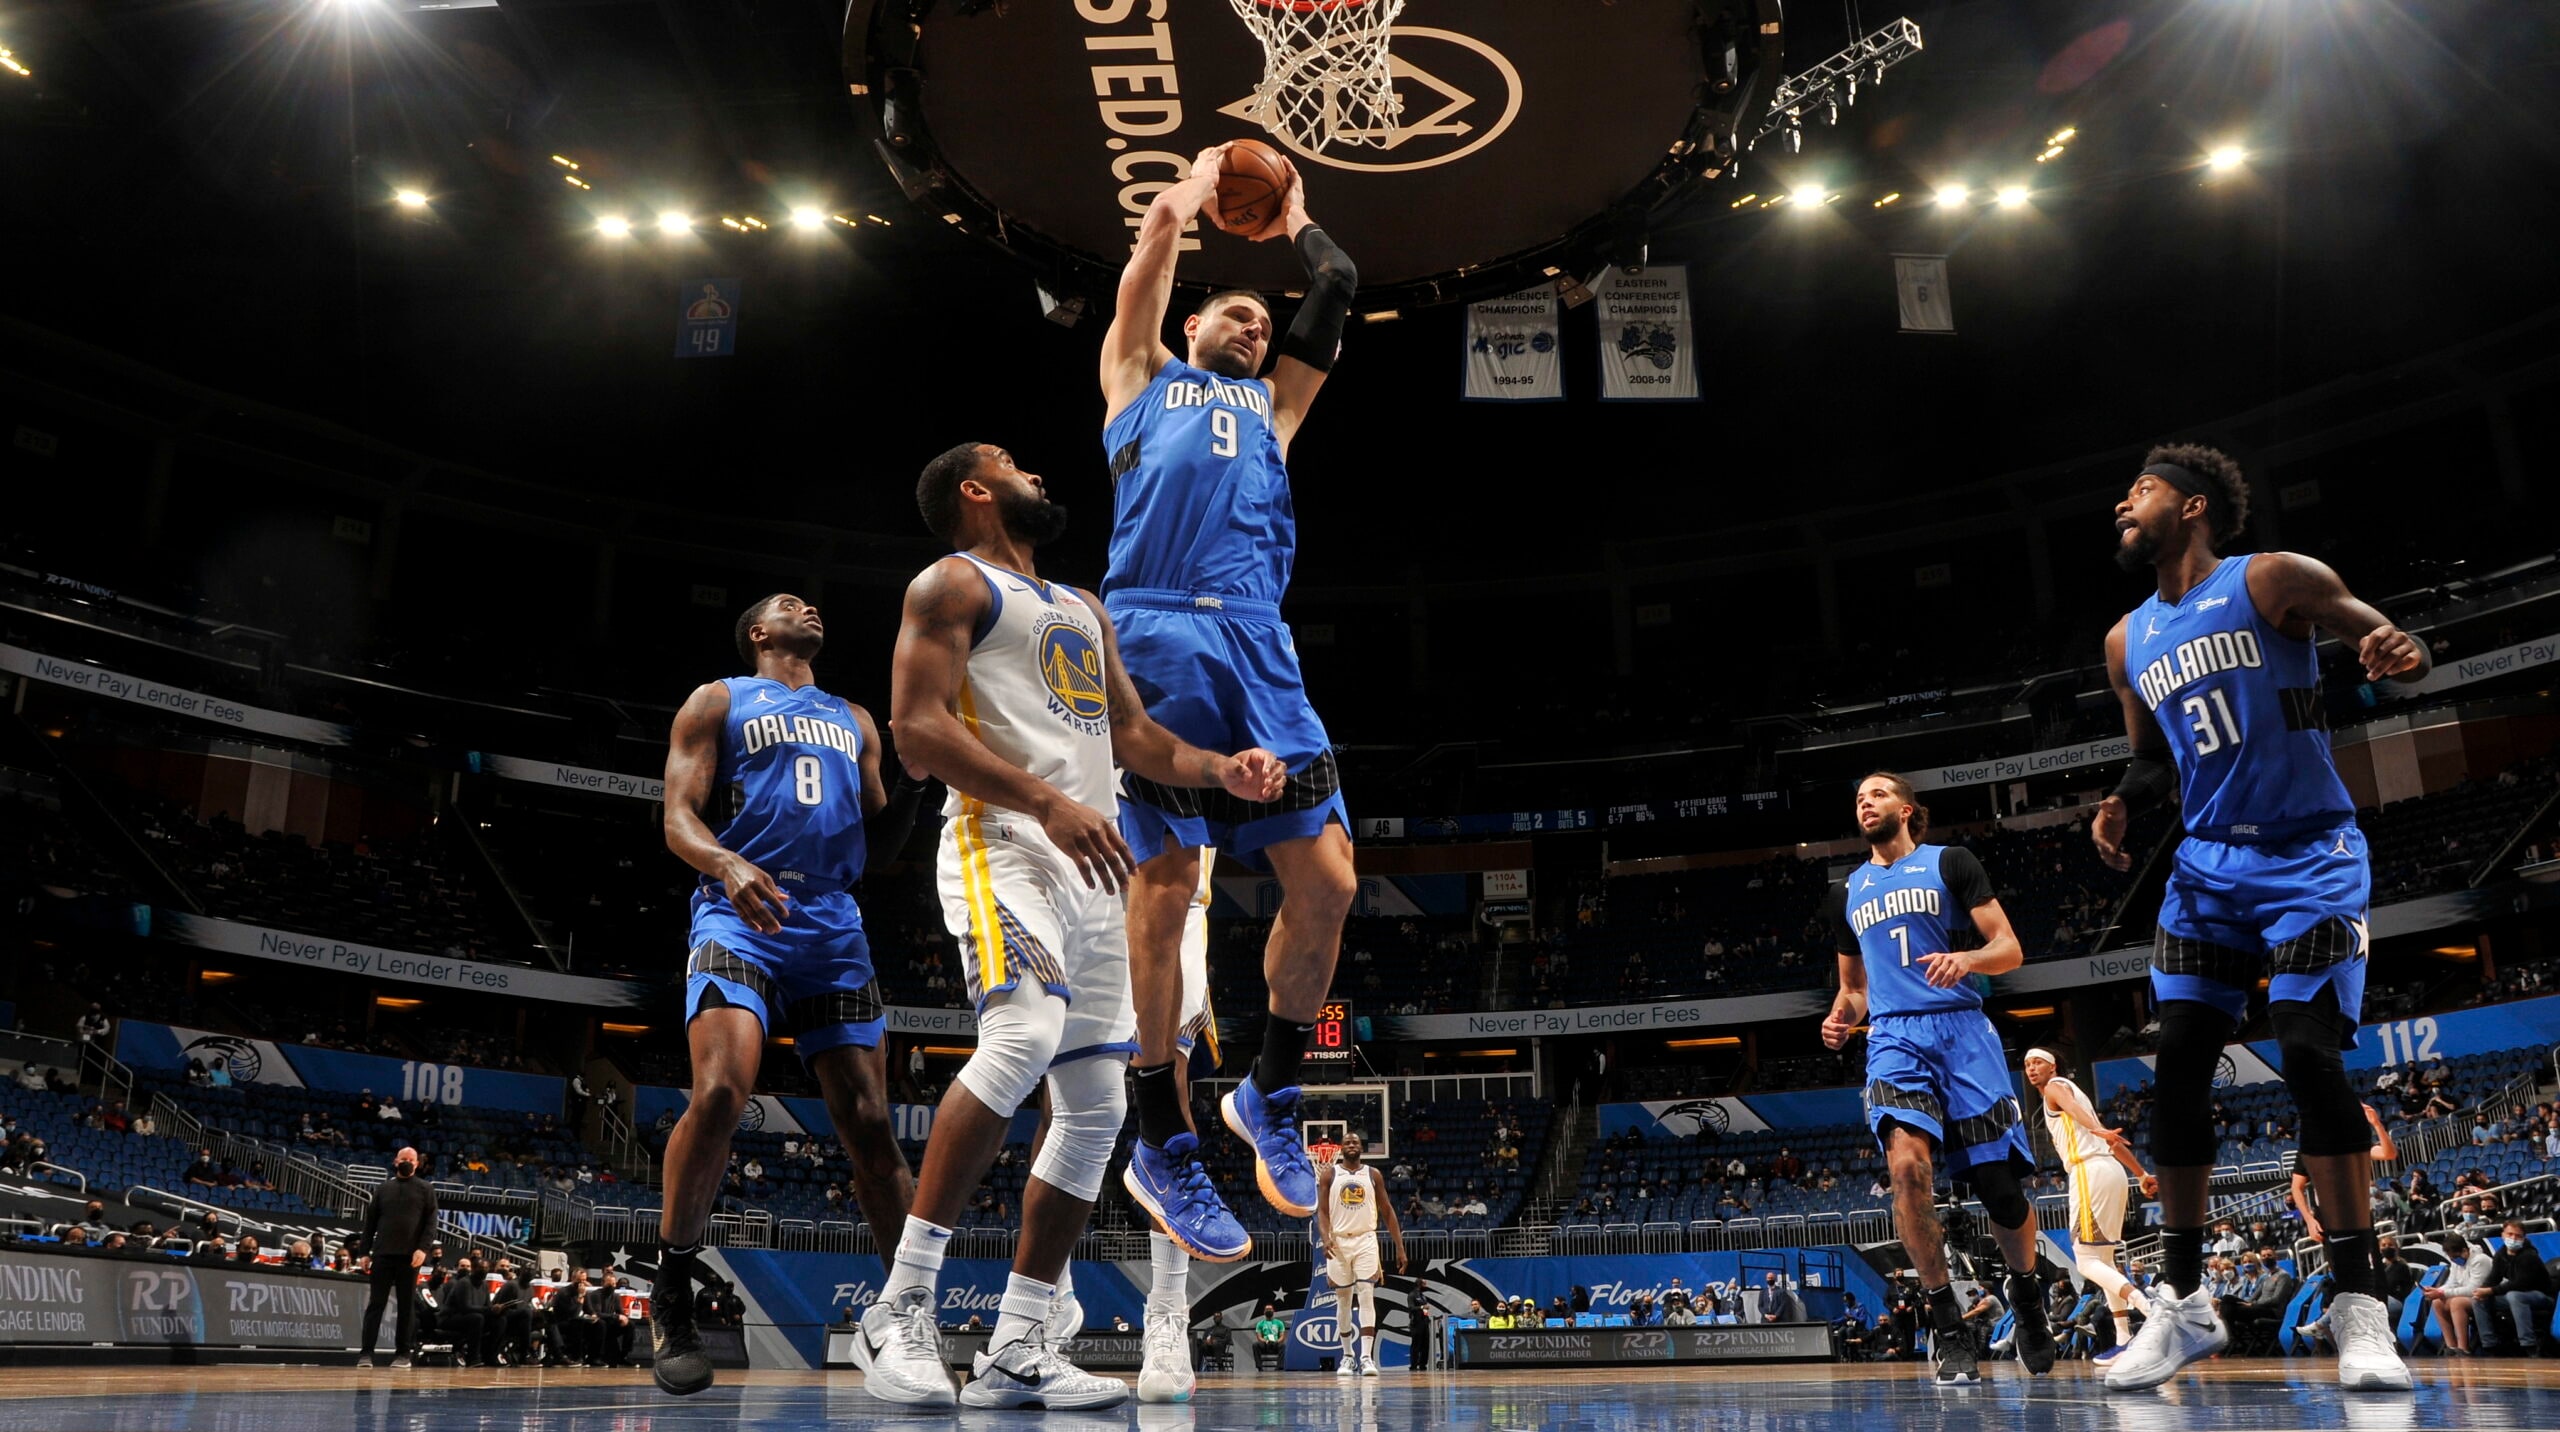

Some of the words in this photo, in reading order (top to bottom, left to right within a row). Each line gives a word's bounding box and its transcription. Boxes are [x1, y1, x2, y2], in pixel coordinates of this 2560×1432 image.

[1615, 279, 1667, 288] EASTERN
[1604, 291, 1681, 301] CONFERENCE
[1478, 305, 1545, 314] CHAMPIONS
[1610, 305, 1678, 314] CHAMPIONS
[692, 328, 720, 352] 49
[1494, 375, 1534, 385] 1994-95
[1629, 375, 1671, 384] 2008-09
[1164, 375, 1271, 431] ORLANDO
[1211, 407, 1239, 459] 9
[1195, 596, 1223, 610] MAGIC
[2195, 596, 2229, 611] Disney
[1032, 611, 1064, 635] GOLDEN
[1081, 648, 1098, 676] 10
[2138, 630, 2263, 712] ORLANDO
[2458, 654, 2514, 679] Never
[2519, 643, 2556, 664] Pay
[36, 657, 92, 686] Never
[98, 673, 132, 698] Pay
[137, 683, 199, 712] Lender
[203, 700, 245, 723] Fees
[1047, 695, 1110, 737] WARRIO
[2182, 688, 2242, 757] 31
[743, 713, 858, 764] ORLANDO
[1942, 766, 1990, 784] Never
[1995, 760, 2025, 777] Pay
[2028, 748, 2085, 771] Lender
[2089, 741, 2131, 760] Fees
[556, 767, 604, 788] Never
[608, 775, 638, 796] Pay
[794, 754, 824, 807] 8
[1513, 811, 1530, 822] TEAM
[1534, 813, 1543, 829] 2
[1558, 809, 1574, 819] TIME
[1577, 810, 1587, 826] 5
[1375, 819, 1391, 836] 46
[779, 870, 806, 883] MAGIC
[1494, 872, 1517, 881] 110A
[1495, 883, 1517, 891] 111A
[1851, 887, 1940, 937] ORLANDO
[1888, 924, 1910, 968] 7
[260, 932, 325, 961] Never
[332, 945, 371, 973] Pay
[377, 952, 452, 981] Lender
[458, 964, 509, 989] Fees
[2089, 956, 2151, 978] Never
[893, 1009, 951, 1030] Never
[1317, 1005, 1345, 1020] :55
[1469, 1015, 1527, 1033] Never
[1533, 1013, 1570, 1034] Pay
[1576, 1009, 1646, 1029] Lender
[1652, 1005, 1700, 1024] Fees
[1317, 1021, 1342, 1047] 18
[2376, 1016, 2443, 1068] 112
[1312, 1051, 1350, 1059] TISSOT
[401, 1060, 464, 1106] 108
[895, 1104, 938, 1142] 10
[128, 1270, 192, 1311] RP
[941, 1286, 1000, 1310] Blue
[37, 1311, 86, 1332] LENDER
[131, 1316, 198, 1336] FUNDING
[230, 1319, 262, 1336] DIRECT
[263, 1320, 311, 1338] MORTGAGE
[311, 1322, 343, 1340] LENDER
[1622, 1331, 1666, 1349] RP
[1695, 1347, 1721, 1355] DIRECT
[1723, 1346, 1765, 1354] MORTGAGE
[1083, 1353, 1127, 1361] MORTGAGE
[1489, 1350, 1516, 1359] DIRECT
[1518, 1350, 1560, 1359] MORTGAGE
[1562, 1349, 1592, 1358] LENDER
